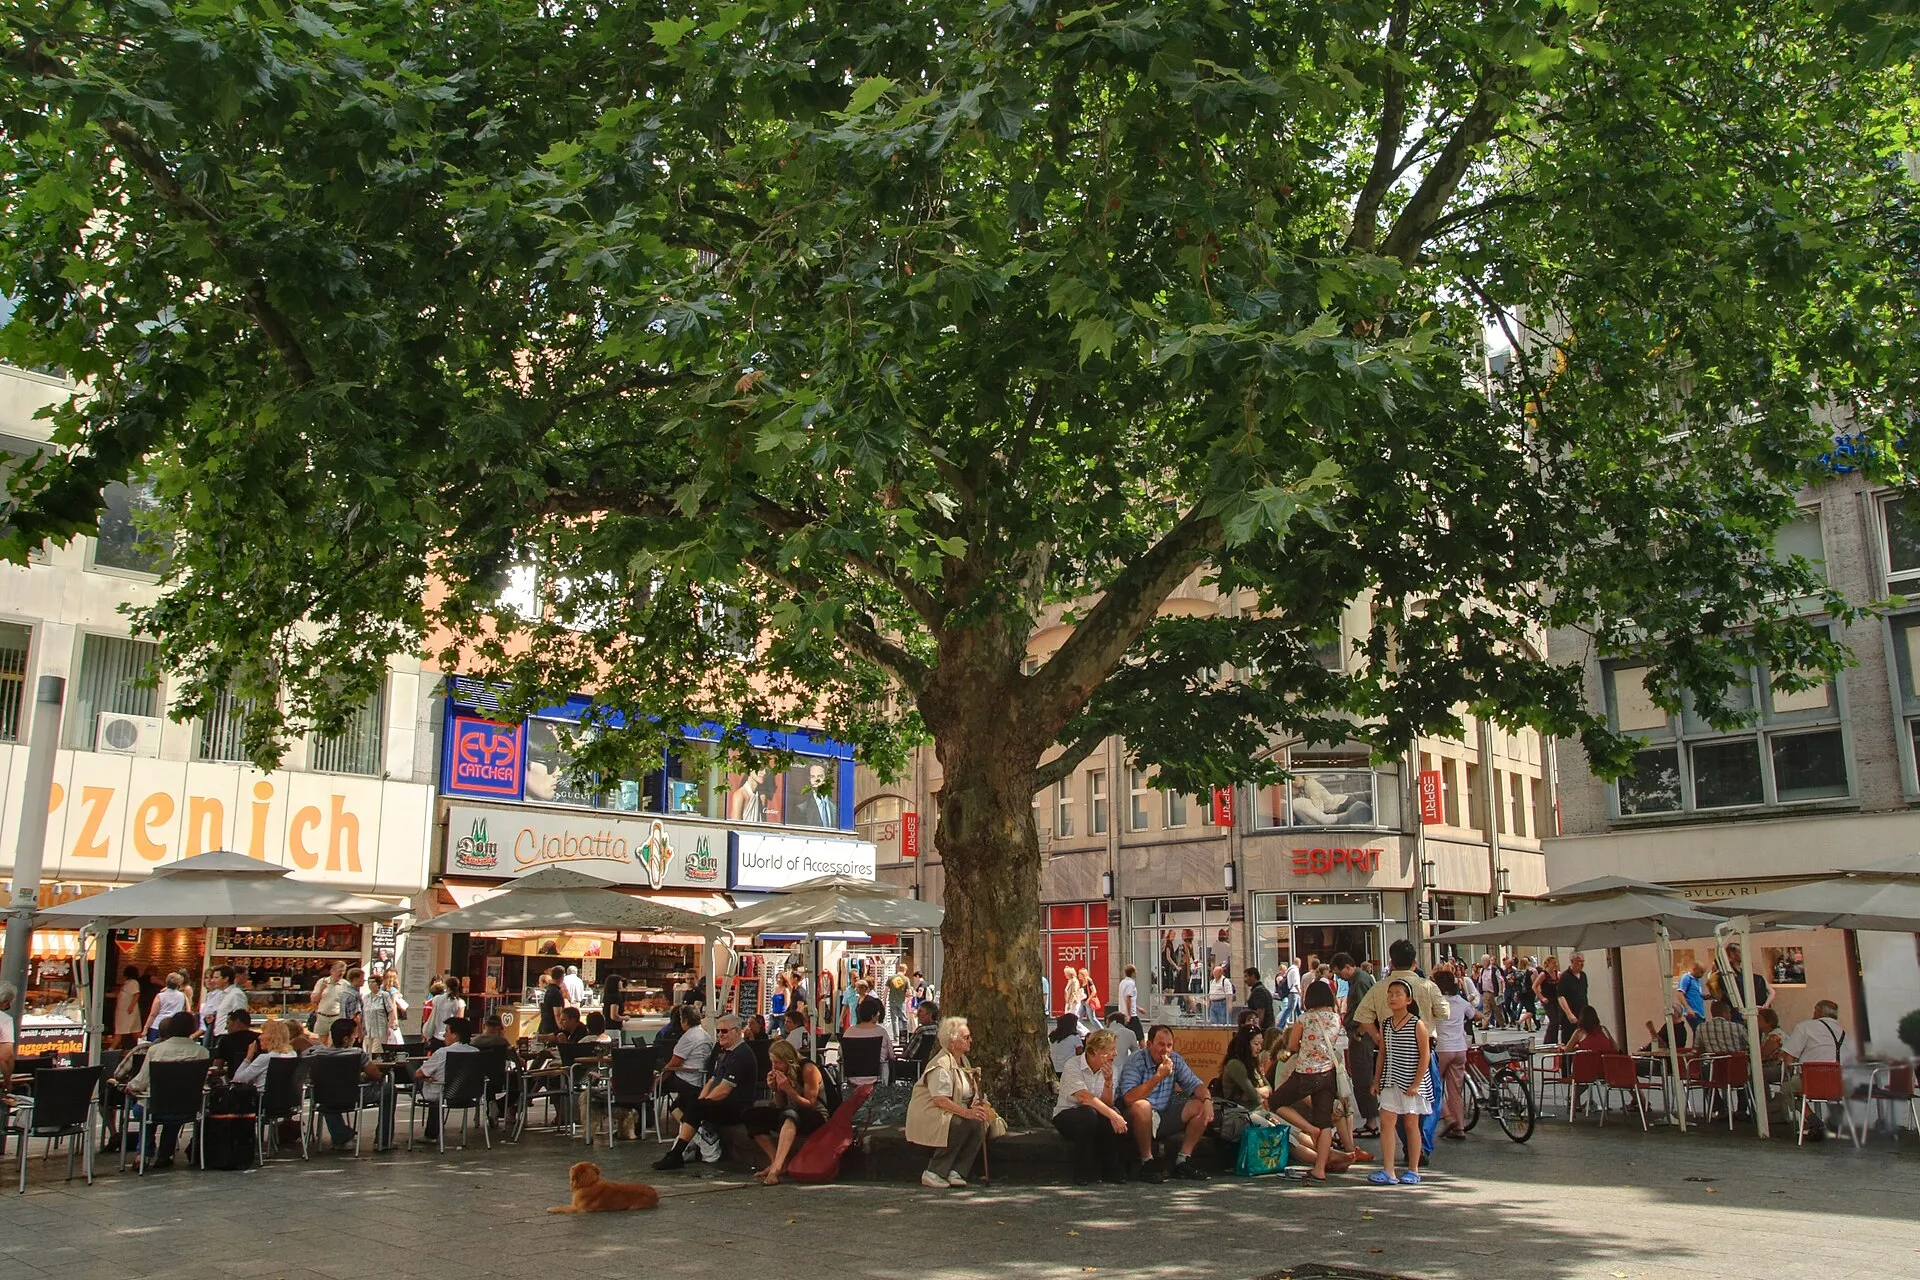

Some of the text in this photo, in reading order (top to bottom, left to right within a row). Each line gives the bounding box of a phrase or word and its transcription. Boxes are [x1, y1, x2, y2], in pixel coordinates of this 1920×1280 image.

[461, 732, 514, 765] EYE
[458, 763, 513, 781] CATCHER
[1423, 775, 1437, 819] ESPRIT
[762, 807, 780, 815] Cartier
[457, 835, 498, 858] Dom
[514, 827, 629, 865] Ciabatta
[907, 816, 916, 852] ESPRIT
[685, 851, 718, 872] Dom
[741, 851, 873, 876] World of Accessoires
[1291, 847, 1385, 875] ESPRIT
[1684, 886, 1758, 898] BVLGARI
